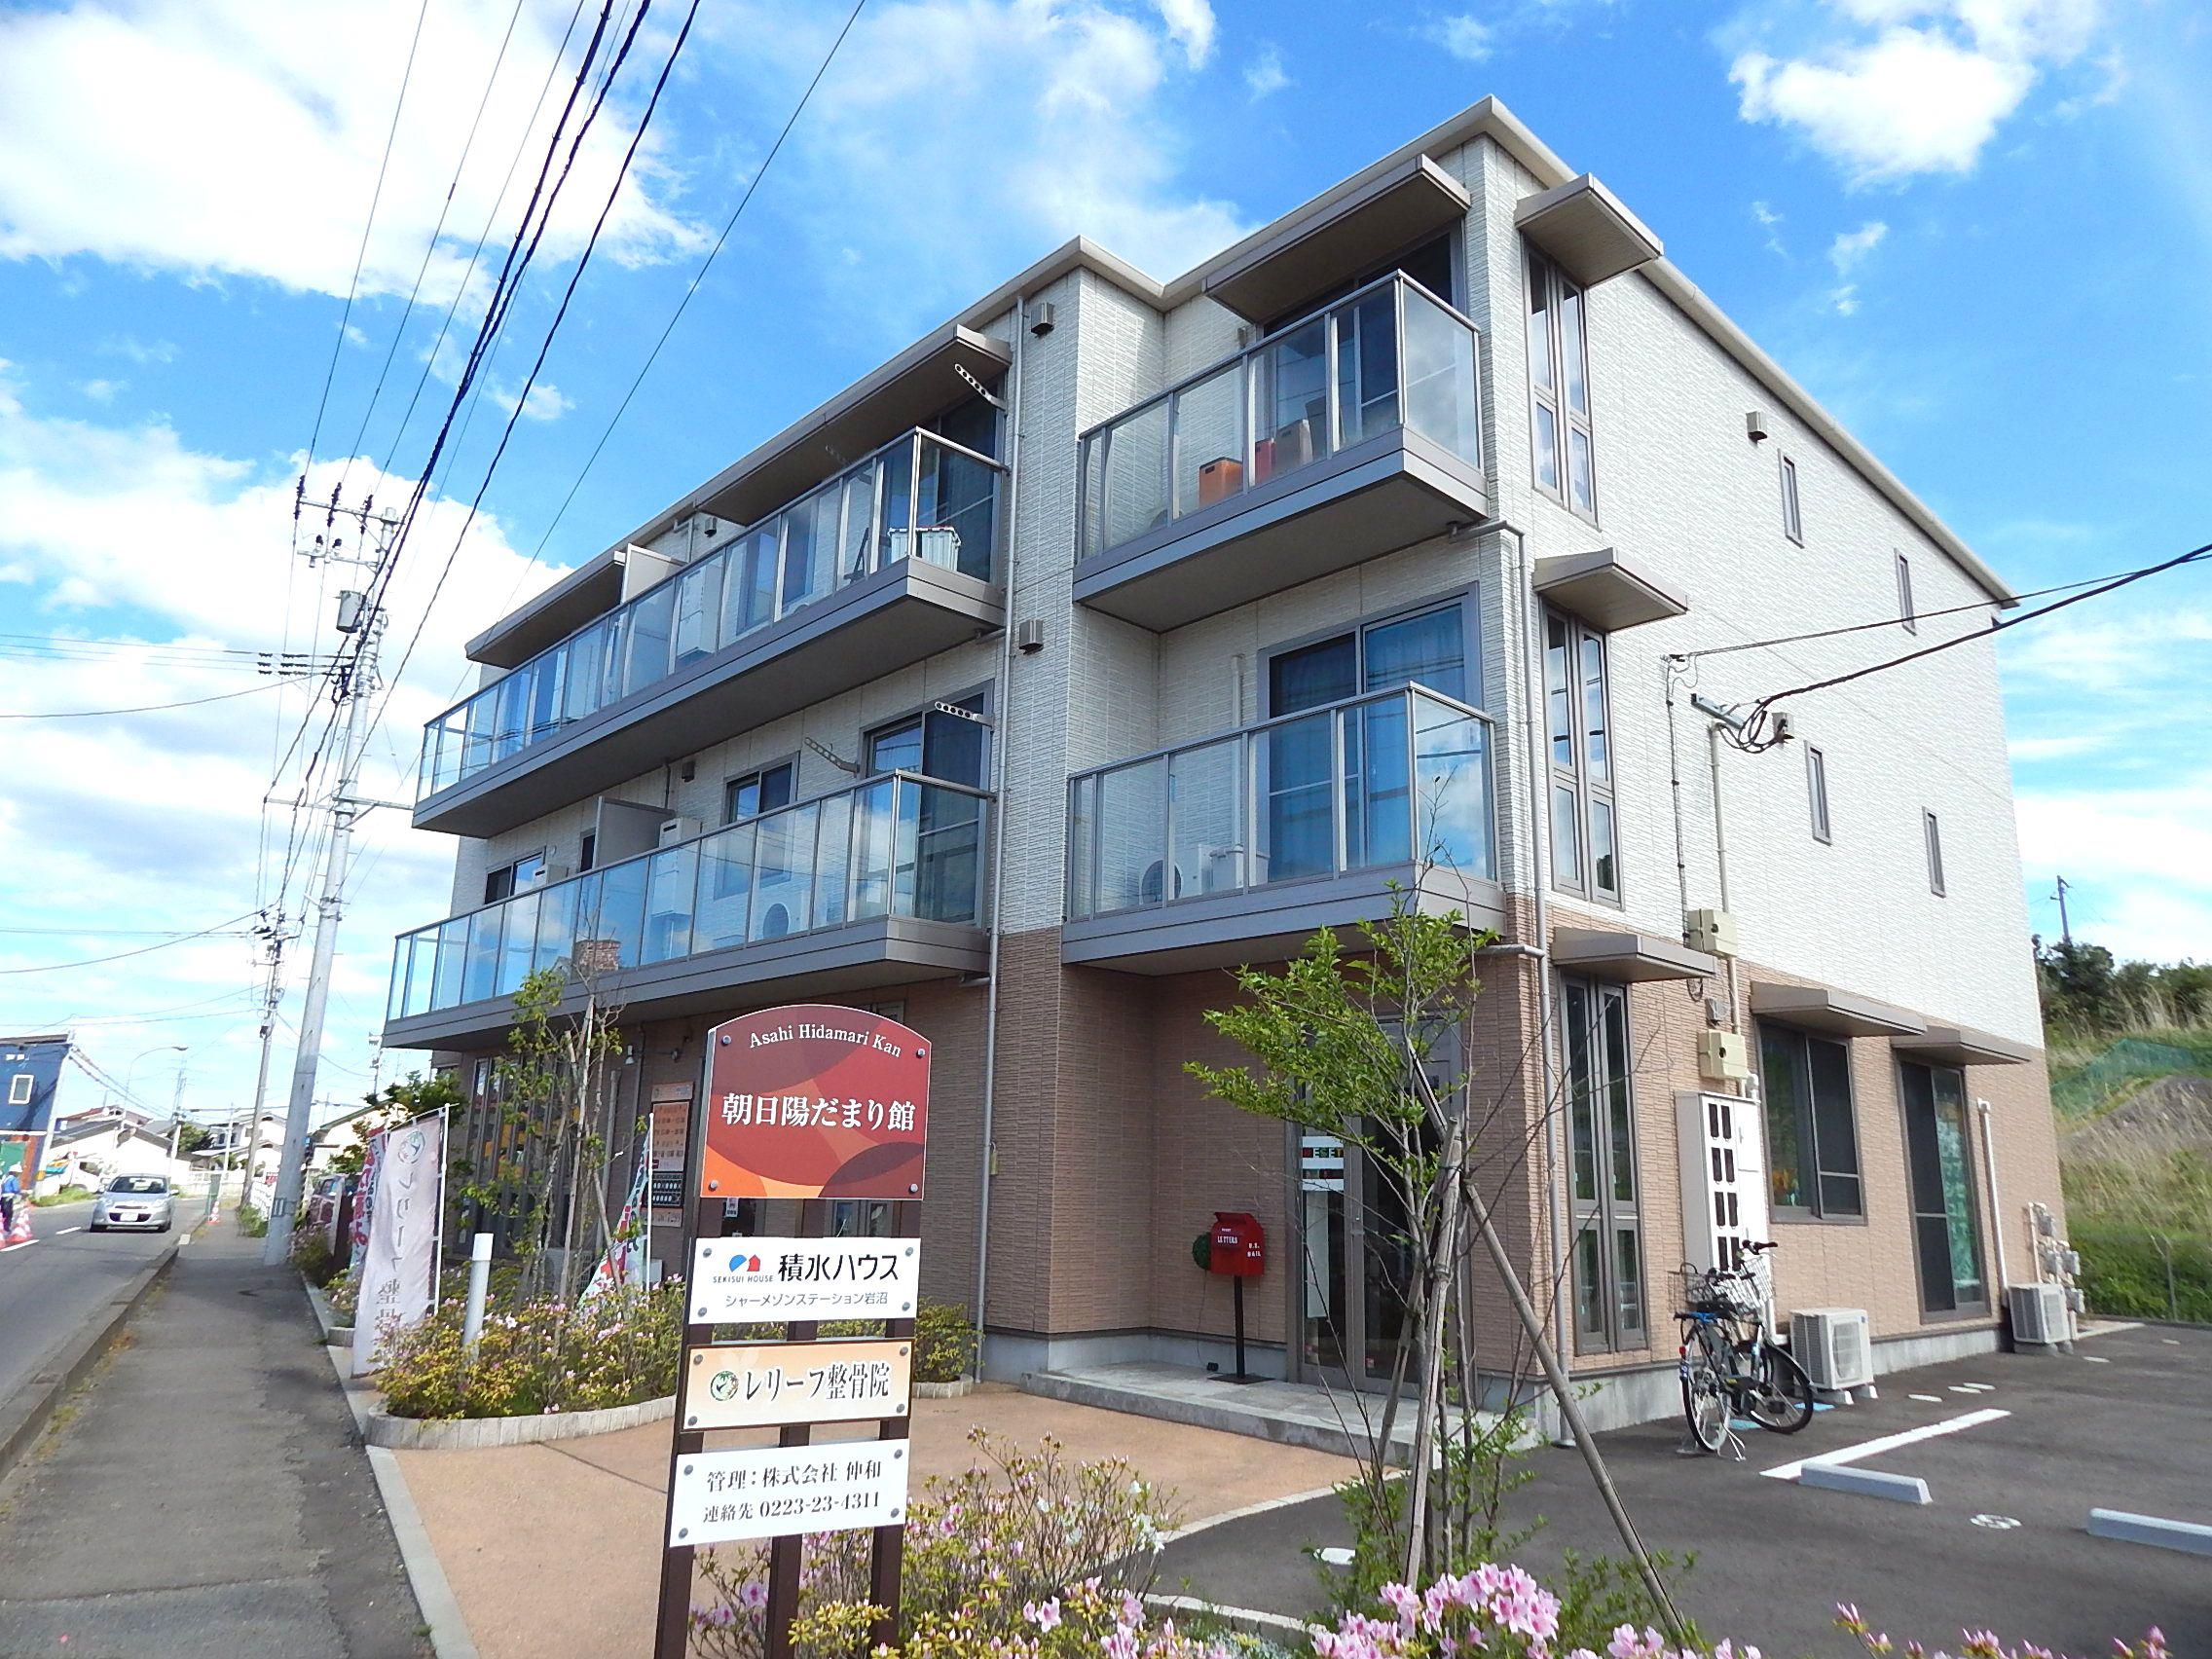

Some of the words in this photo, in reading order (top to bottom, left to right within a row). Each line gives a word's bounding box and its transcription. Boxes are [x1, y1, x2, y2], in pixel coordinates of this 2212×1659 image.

[750, 1025, 793, 1048] Asahi
[798, 1024, 869, 1045] Hidamari
[872, 1035, 902, 1058] Kan
[721, 1092, 916, 1131] 朝日陽だまり館
[778, 1253, 898, 1282] 積水ハウス
[746, 1362, 890, 1402] レリーフ整骨院
[703, 1502, 754, 1524] 連絡先
[759, 1491, 879, 1518] 0223-23-4311
